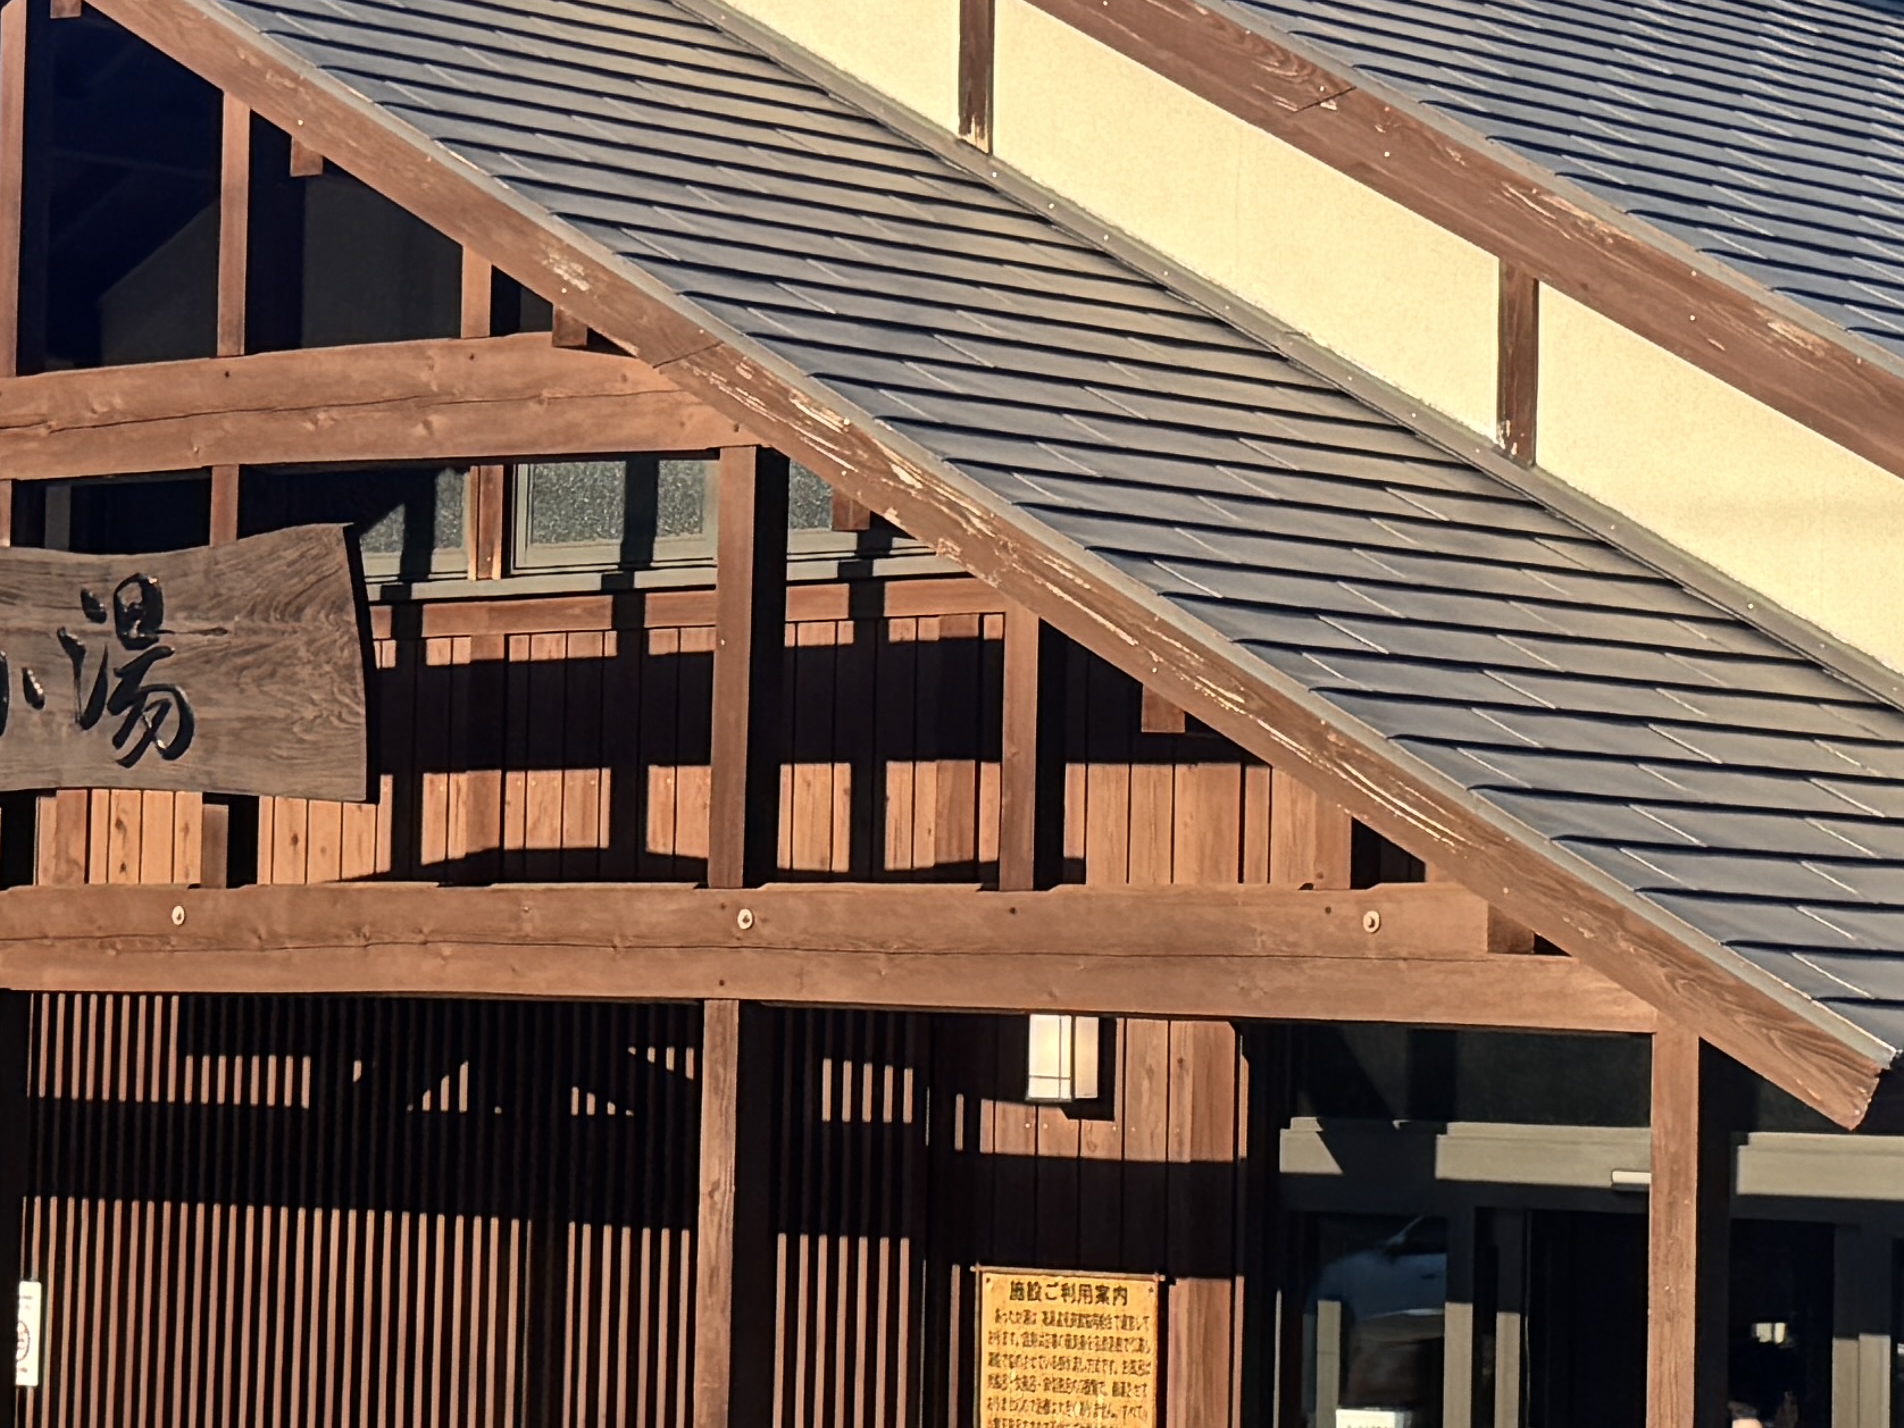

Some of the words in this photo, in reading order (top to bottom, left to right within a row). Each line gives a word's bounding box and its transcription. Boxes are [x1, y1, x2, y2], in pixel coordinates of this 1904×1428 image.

[1009, 1280, 1129, 1307] 施設ご利用案内
